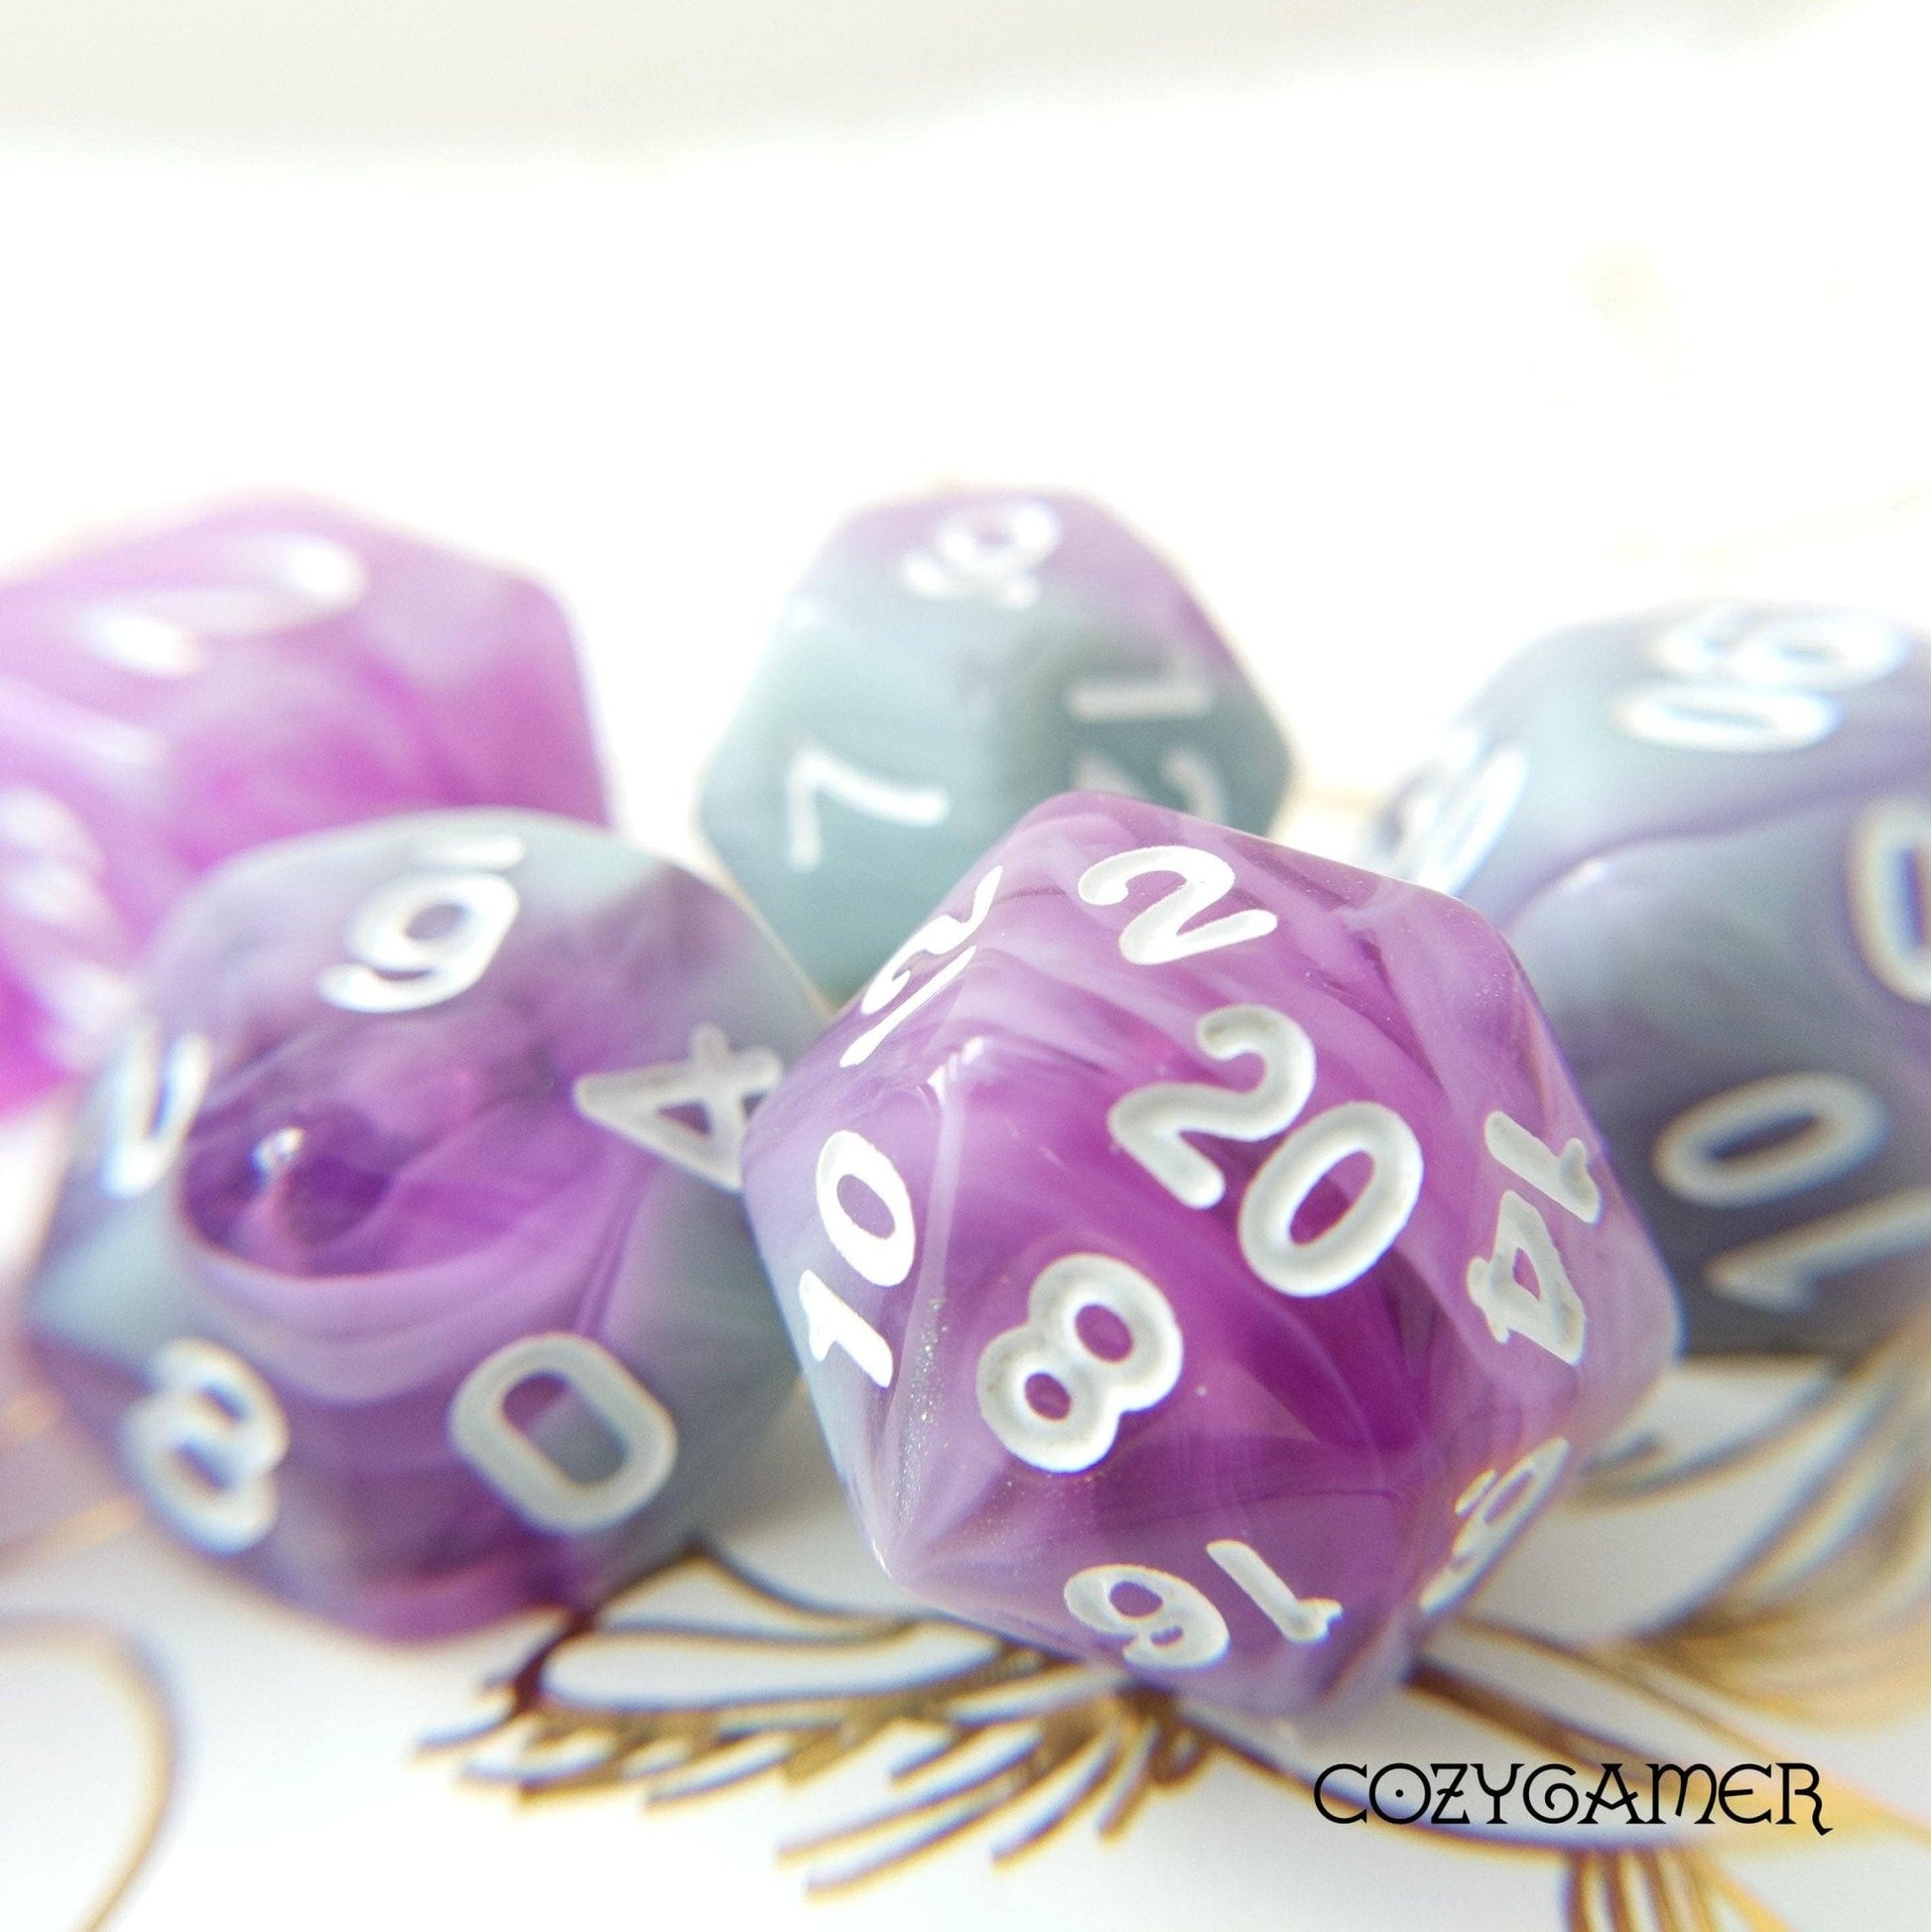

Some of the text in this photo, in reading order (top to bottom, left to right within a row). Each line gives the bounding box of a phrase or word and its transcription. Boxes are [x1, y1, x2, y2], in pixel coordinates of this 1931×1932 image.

[786, 751, 949, 871] 7
[1078, 844, 1279, 966] 2
[573, 1023, 784, 1191] 4
[1106, 1002, 1424, 1297] 20
[799, 1130, 916, 1387] 10
[1468, 1110, 1601, 1365] 14
[448, 1332, 678, 1536] 0
[976, 1252, 1184, 1474] 8
[1064, 1539, 1343, 1669] 16
